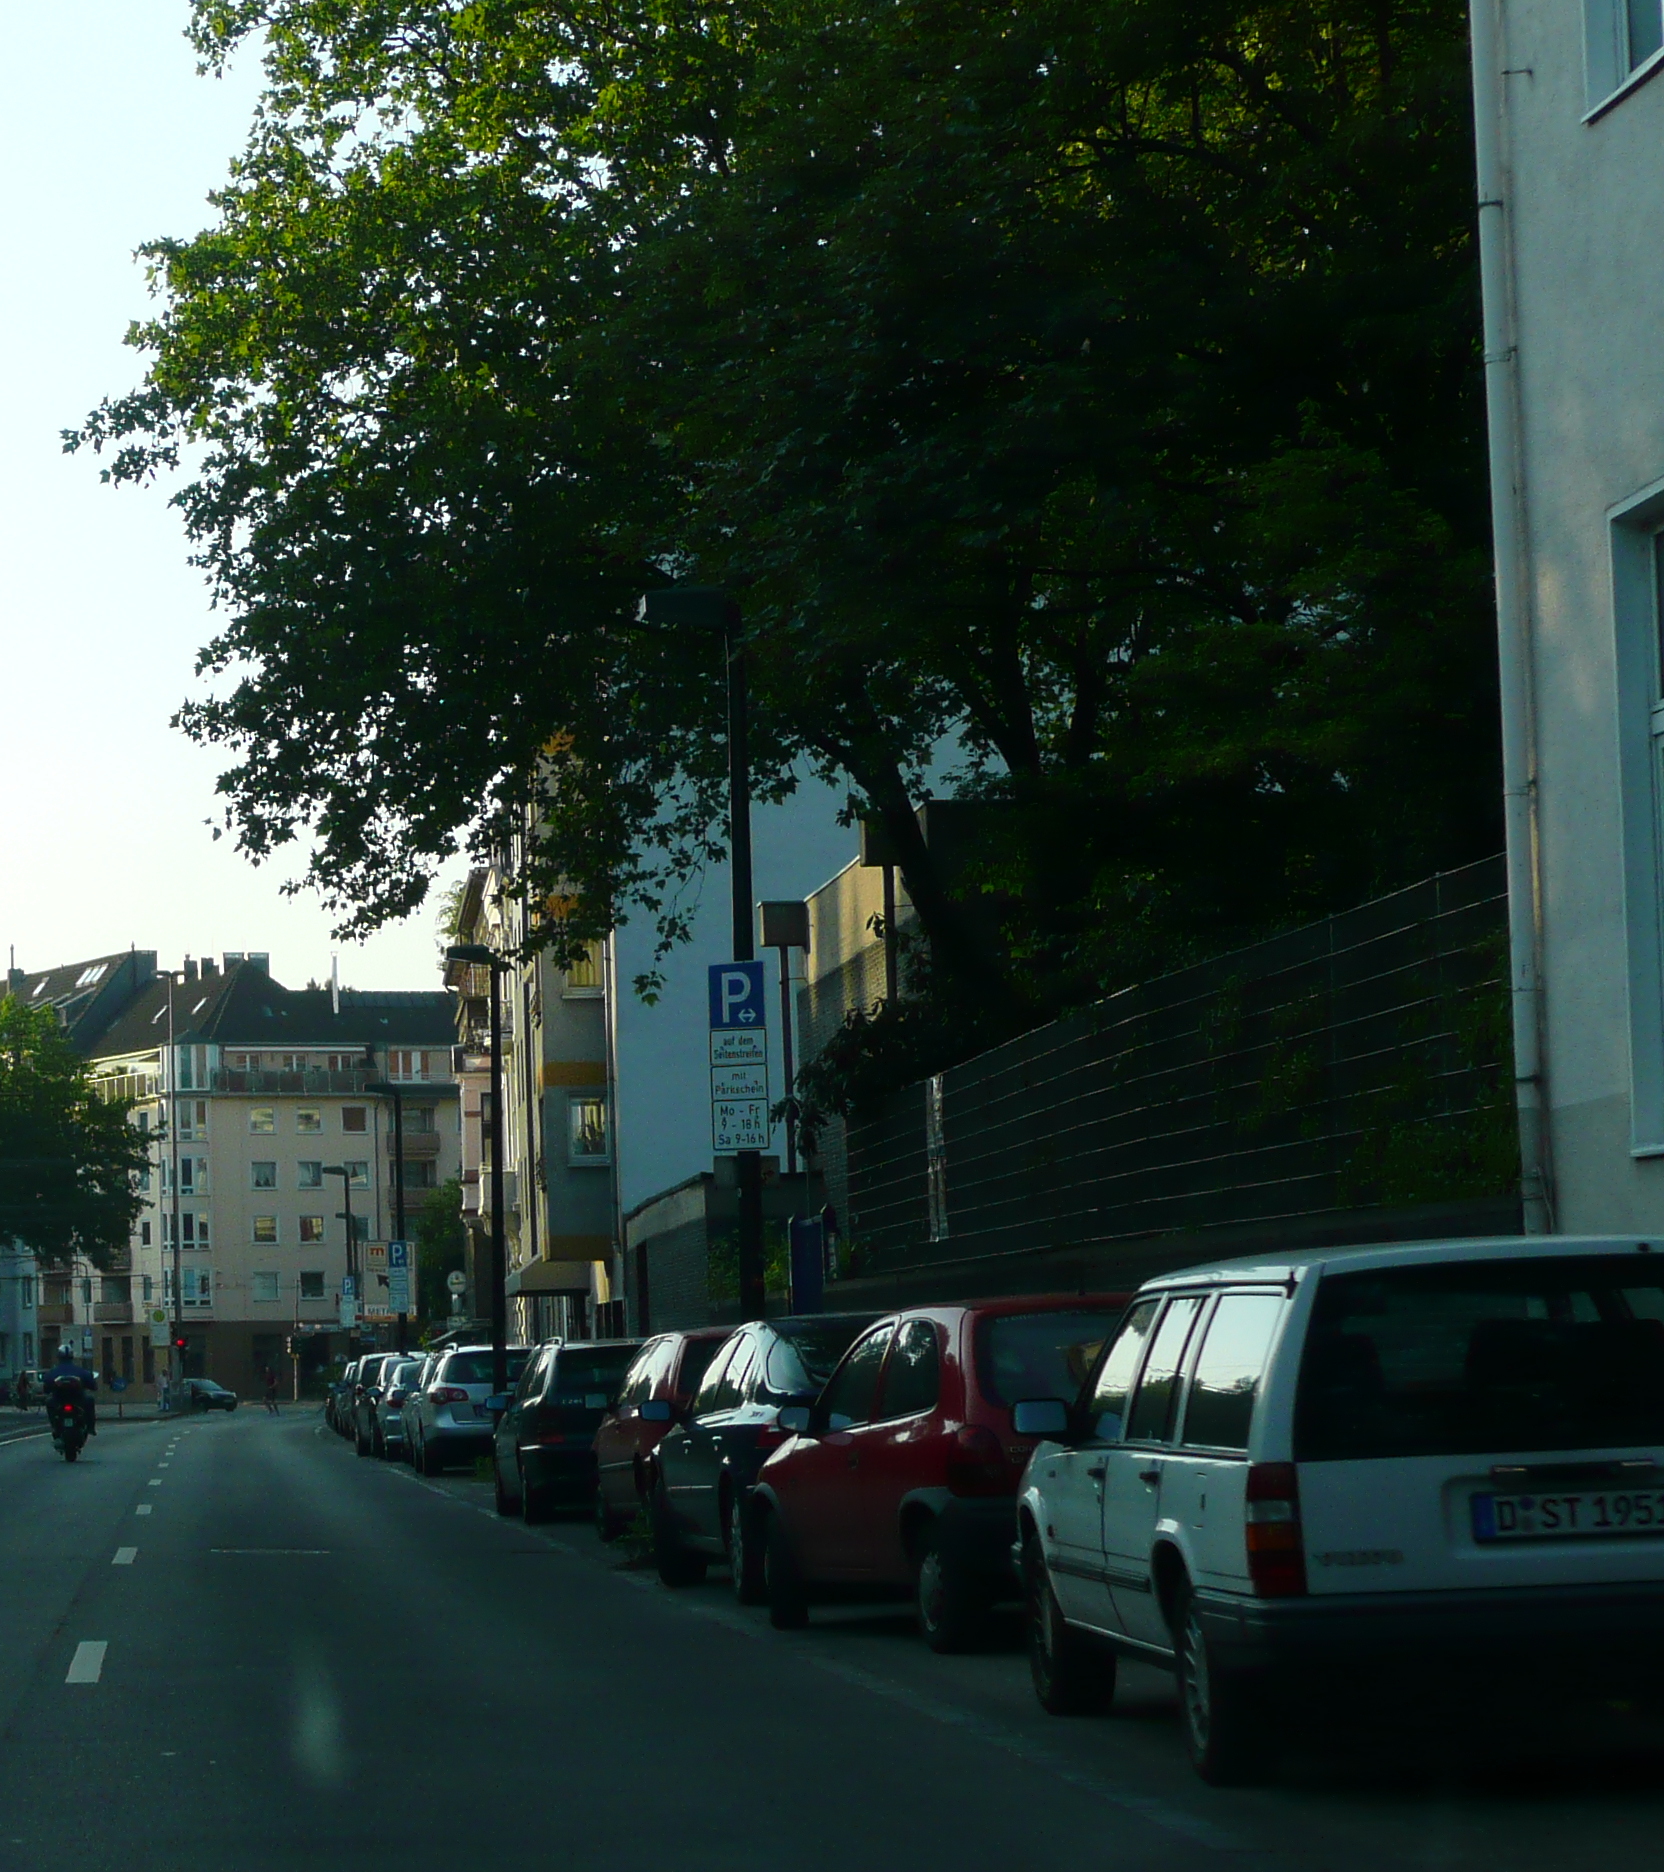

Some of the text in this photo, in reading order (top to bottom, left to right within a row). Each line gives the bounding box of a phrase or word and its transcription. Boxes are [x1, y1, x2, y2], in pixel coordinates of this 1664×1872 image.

[721, 971, 751, 1023] P
[723, 1035, 754, 1046] auf dem
[713, 1047, 763, 1060] Seitenstreifen
[731, 1072, 746, 1081] mit
[715, 1083, 764, 1095] Parkschein
[720, 1105, 735, 1116] Mo
[748, 1104, 760, 1115] Fr
[721, 1119, 727, 1130] 9
[741, 1119, 752, 1130] 18
[754, 1117, 760, 1129] h
[718, 1134, 731, 1145] Sa
[758, 1133, 765, 1144] h
[392, 1244, 403, 1265] P
[344, 1279, 351, 1294] P
[1498, 1500, 1517, 1531] D
[1541, 1497, 1582, 1528] ST
